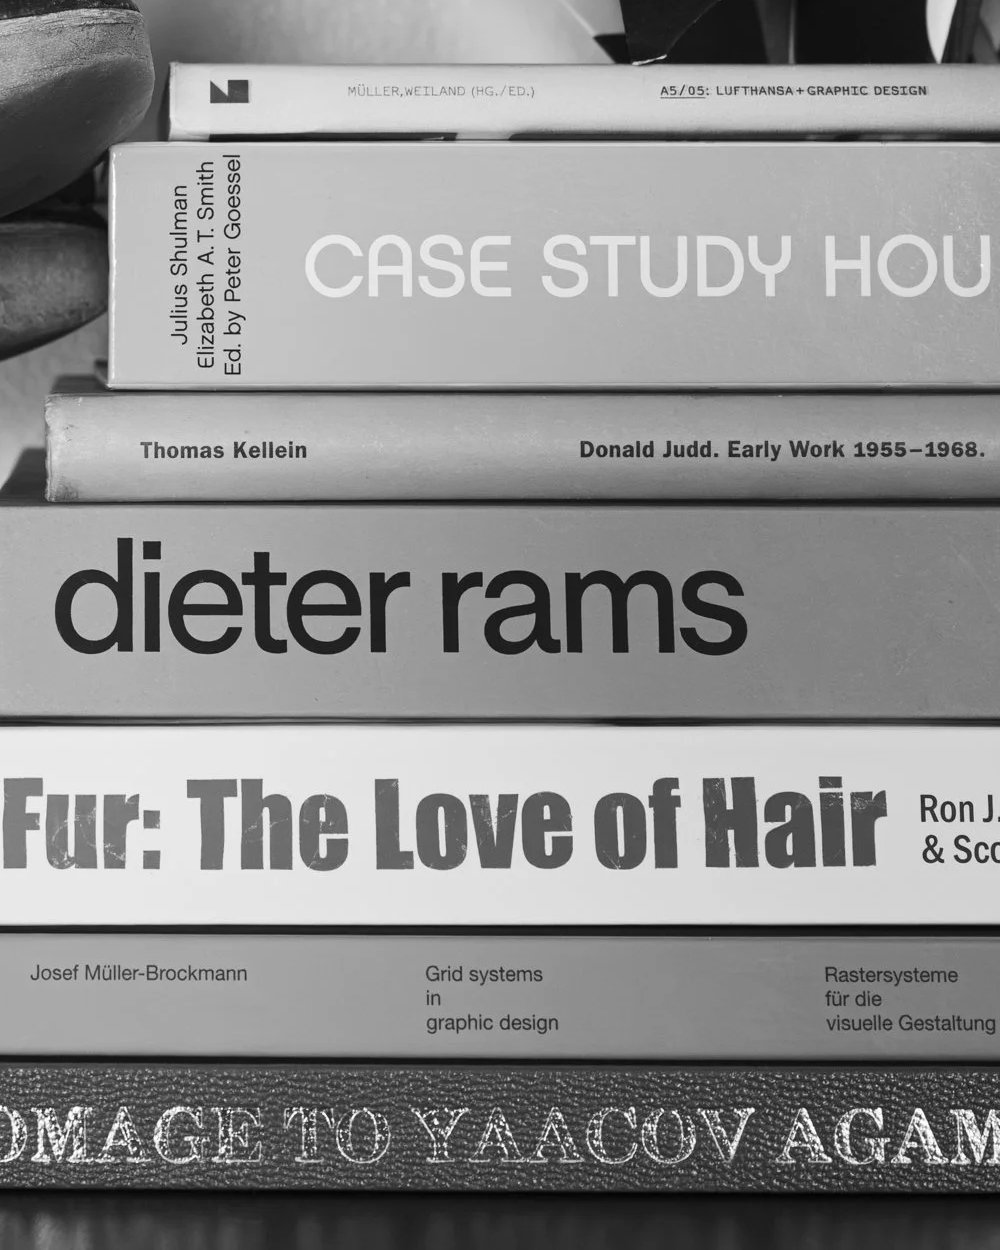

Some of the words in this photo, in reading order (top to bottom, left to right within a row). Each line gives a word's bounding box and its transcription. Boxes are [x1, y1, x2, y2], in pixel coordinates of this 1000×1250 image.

[472, 86, 534, 98] (HG./ED.)
[661, 85, 709, 98] A5/05:
[874, 86, 926, 95] DESIGN
[196, 162, 214, 220] Smith
[223, 155, 241, 239] Goessel
[169, 185, 187, 276] Shulman
[197, 228, 214, 243] T.
[197, 246, 214, 265] A.
[305, 235, 511, 297] CASE
[542, 235, 791, 297] STUDY
[825, 234, 990, 297] HOU
[224, 248, 241, 301] Peter
[170, 284, 187, 345] Julius
[196, 274, 214, 368] Elizabeth
[223, 311, 246, 335] by
[223, 344, 241, 375] Ed.
[140, 442, 224, 458] Thomas
[234, 441, 306, 458] Kellein
[581, 441, 654, 457] Donald
[663, 441, 718, 457] Judd.
[729, 441, 781, 461] Early
[789, 441, 844, 457] Work
[55, 538, 410, 655] dieter
[442, 570, 747, 655] rams
[920, 795, 974, 823] Ron
[3, 778, 160, 869] Fur:
[187, 779, 348, 871] The
[375, 779, 573, 870] Love
[594, 778, 681, 870] of
[703, 776, 887, 868] Hair
[922, 835, 944, 863] &
[30, 965, 79, 980] Josef
[85, 965, 247, 981] Müller-Brockmann
[426, 965, 462, 981] Grid
[470, 967, 543, 986] systems
[825, 967, 958, 986] Rastersysteme
[427, 990, 440, 1005] in
[825, 990, 849, 1006] für
[855, 991, 881, 1006] die
[427, 1014, 493, 1034] graphic
[500, 1014, 558, 1034] design
[827, 1015, 892, 1031] visuelle
[899, 1015, 995, 1035] Gestaltung
[283, 1107, 392, 1163] TO
[411, 1106, 756, 1164] YAACOV
[776, 1107, 1000, 1165] AGAM
